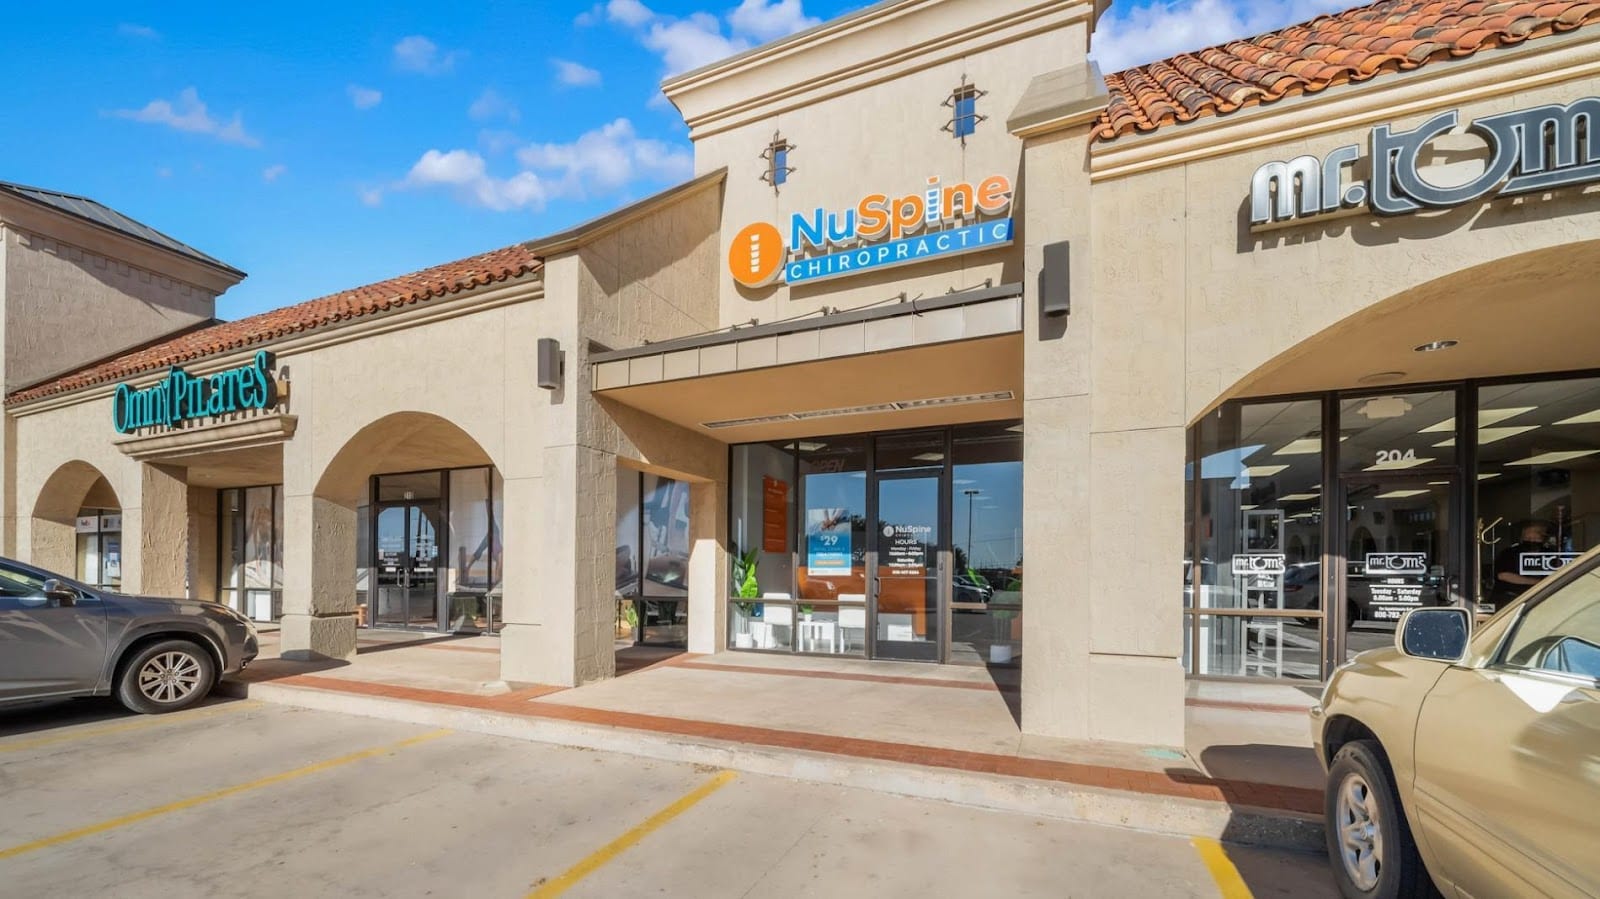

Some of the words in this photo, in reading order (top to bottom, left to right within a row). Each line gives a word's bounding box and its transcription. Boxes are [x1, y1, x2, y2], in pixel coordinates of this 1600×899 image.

[789, 174, 1011, 253] NuSpine
[789, 222, 1008, 280] CHIROPRACTIC
[1375, 448, 1417, 465] 204
[895, 526, 931, 534] NuSpine
[1397, 588, 1422, 596] Saturday
